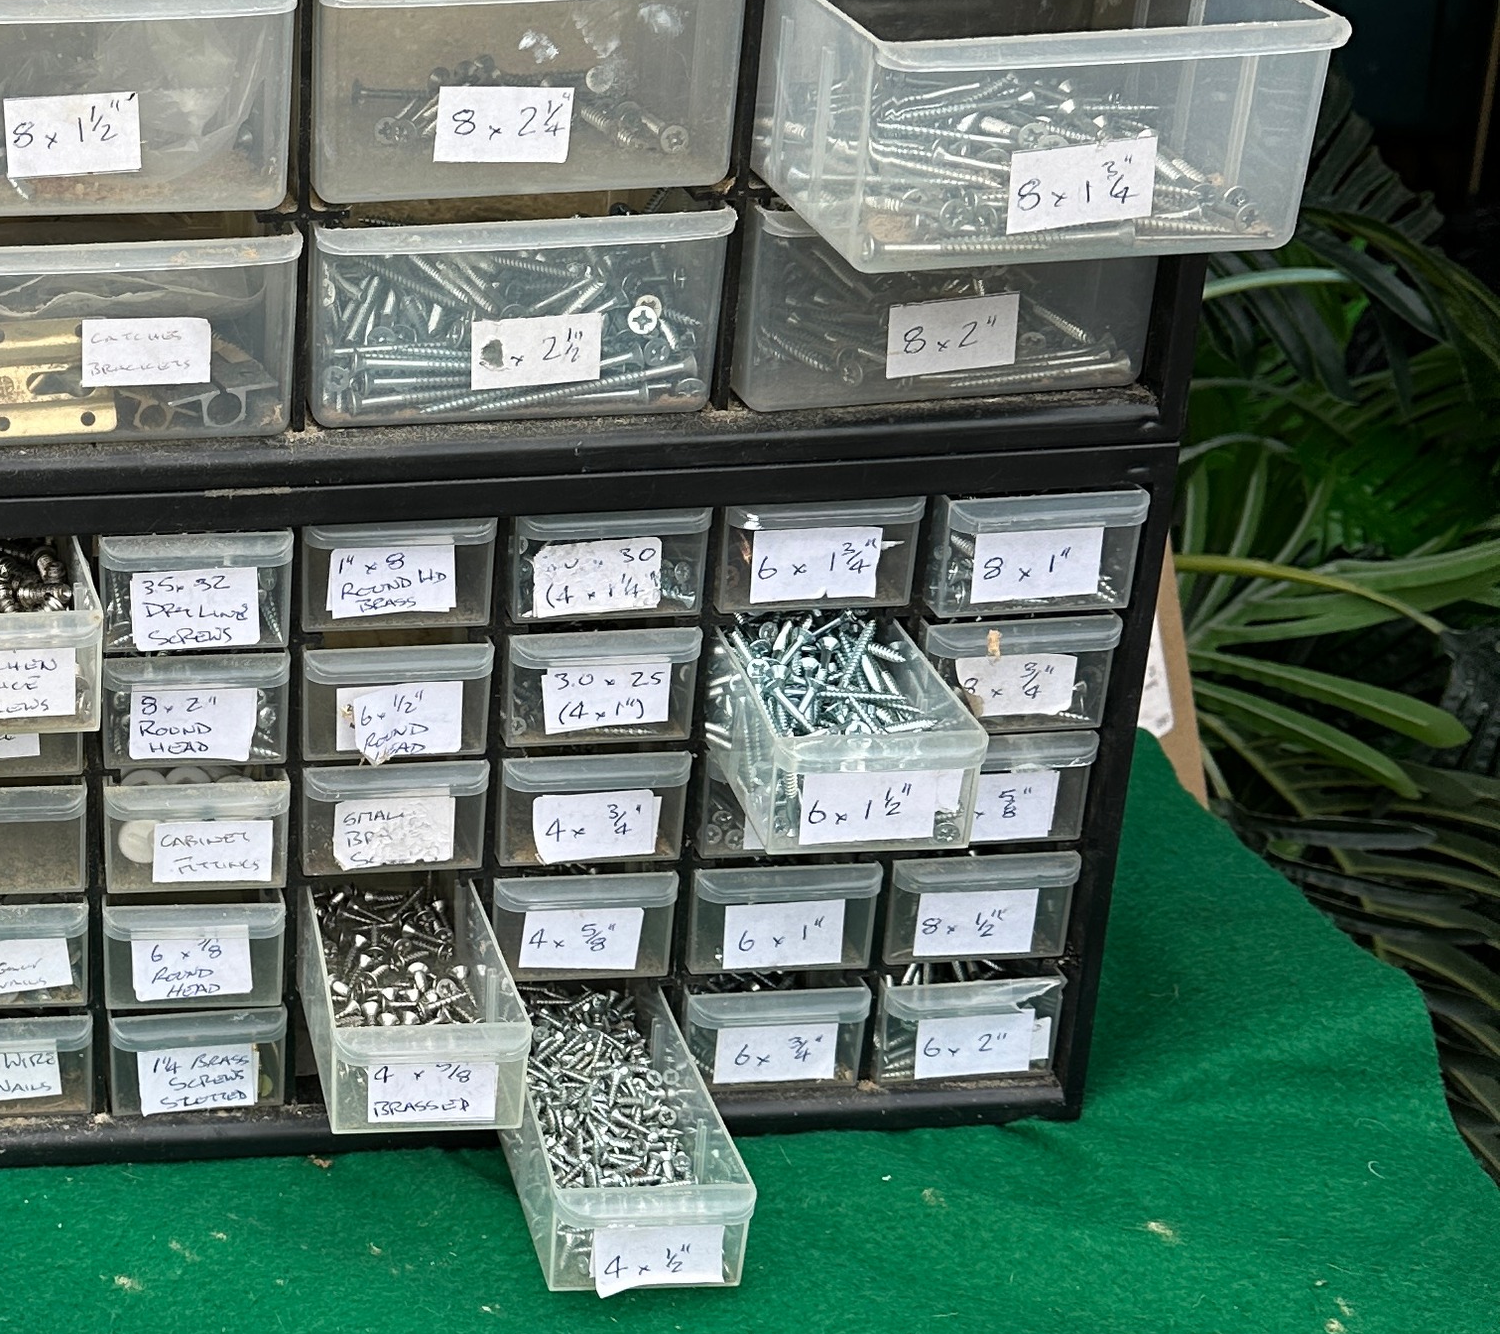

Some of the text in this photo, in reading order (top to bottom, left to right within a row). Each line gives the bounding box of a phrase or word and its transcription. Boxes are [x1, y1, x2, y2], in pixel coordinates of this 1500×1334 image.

[451, 108, 476, 136] 8
[12, 121, 35, 149] 8
[1017, 178, 1042, 211] 8
[903, 325, 927, 354] 8
[959, 314, 998, 348] 2"
[338, 554, 355, 575] 1"
[385, 552, 406, 571] 8
[757, 555, 778, 581] 6
[983, 556, 1004, 581] 8
[1048, 546, 1072, 573] 1"
[340, 576, 413, 604] ROUND
[147, 626, 235, 648] SCREWS
[630, 671, 665, 688] 25
[140, 695, 158, 716] 8
[186, 696, 217, 713] 2"
[360, 705, 373, 727] 6
[138, 719, 212, 737] ROUND
[148, 740, 209, 755] HEAD
[807, 799, 827, 825] 6
[545, 817, 567, 843] 4
[528, 927, 548, 949] 4
[738, 930, 755, 952] 6
[802, 915, 825, 941] 1"
[921, 917, 943, 936] 8
[150, 944, 164, 963] 6
[734, 1044, 751, 1066] 6
[923, 1037, 942, 1058] 6
[977, 1032, 1008, 1053] 2"
[373, 1065, 394, 1084] 4
[603, 1254, 629, 1279] 4
